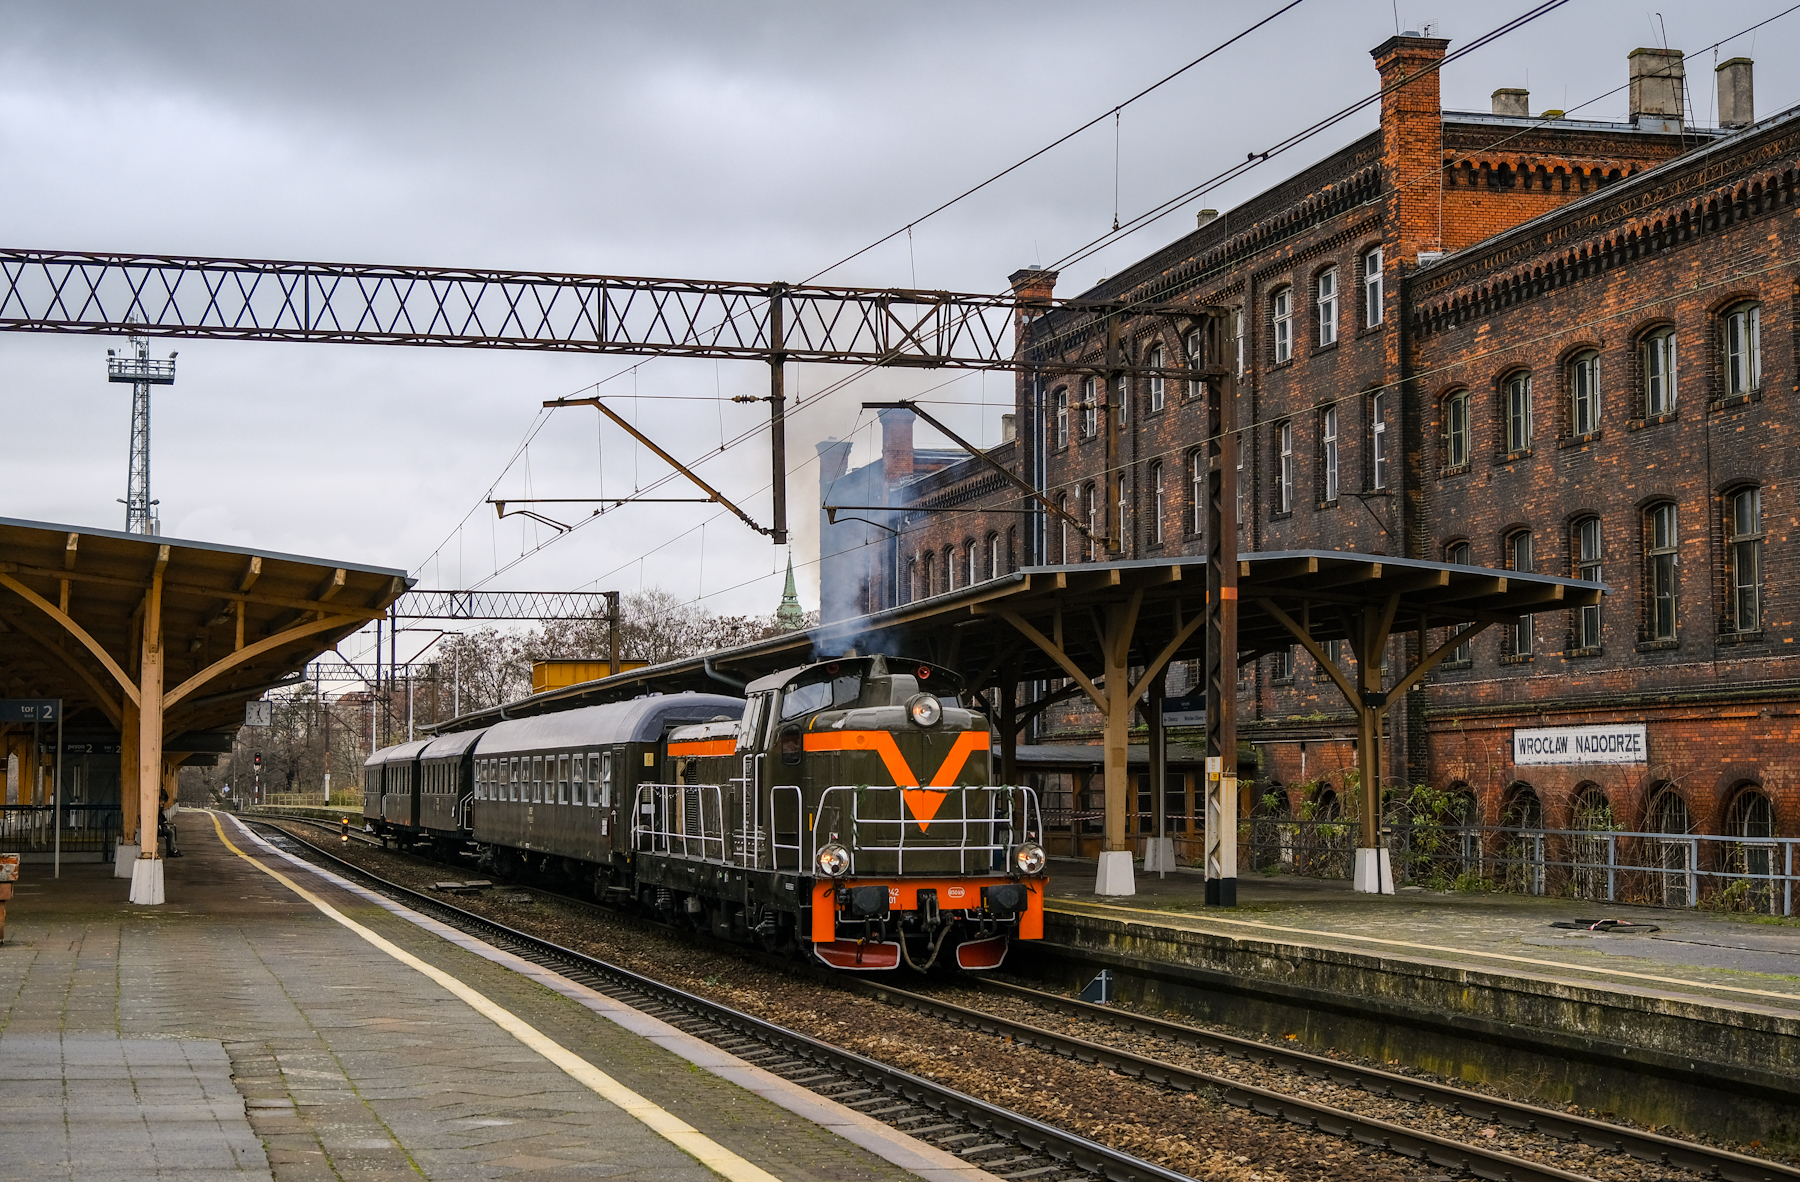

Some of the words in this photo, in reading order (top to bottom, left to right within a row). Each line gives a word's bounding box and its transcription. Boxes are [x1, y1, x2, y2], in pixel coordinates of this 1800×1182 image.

[21, 705, 34, 713] tor
[42, 705, 53, 718] 2
[85, 744, 93, 753] 2
[1518, 736, 1568, 754] WROCŁAW
[1575, 733, 1641, 753] NADODRZE
